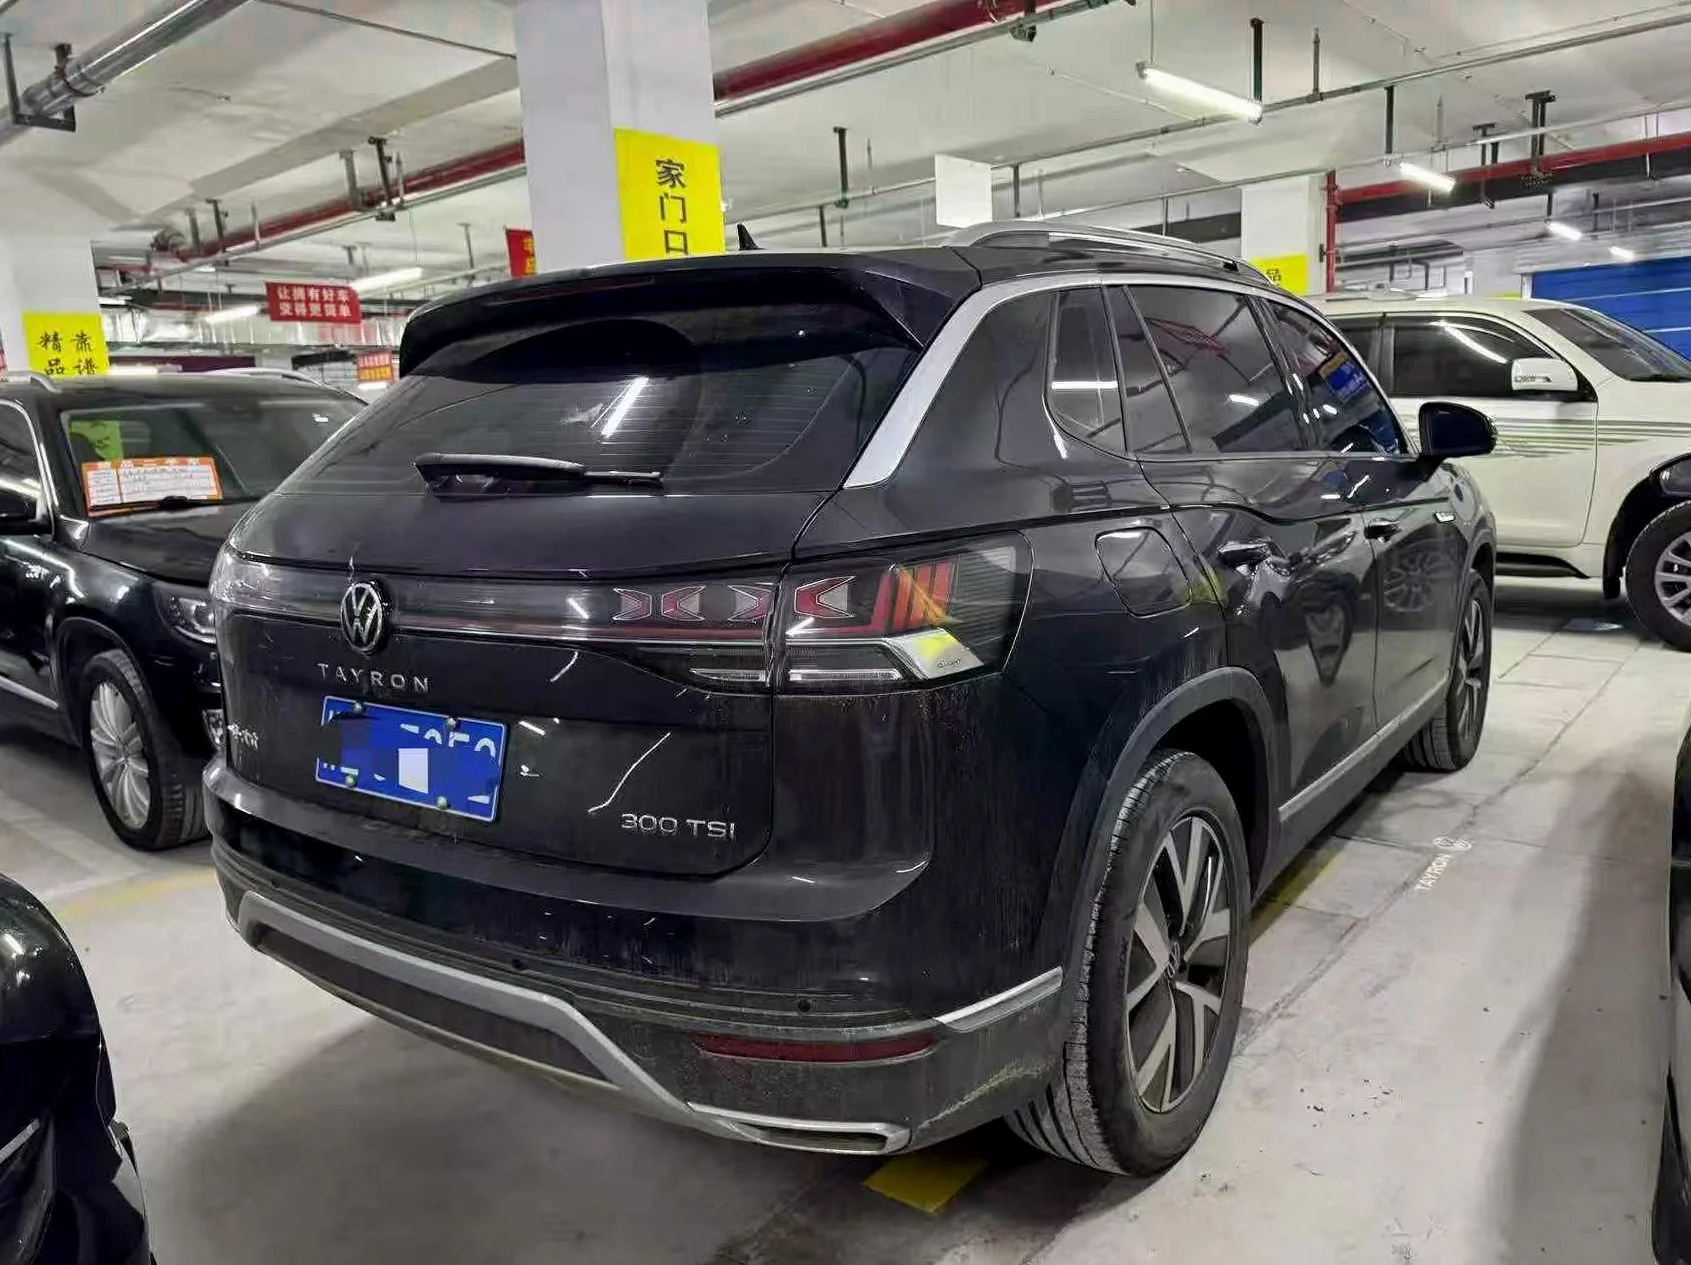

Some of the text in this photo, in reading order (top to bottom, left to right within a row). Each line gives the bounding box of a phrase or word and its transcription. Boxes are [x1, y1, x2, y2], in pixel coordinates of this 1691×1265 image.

[655, 158, 689, 256] 家门口
[316, 662, 430, 693] TAYRON
[621, 812, 736, 840] 300 TSI
